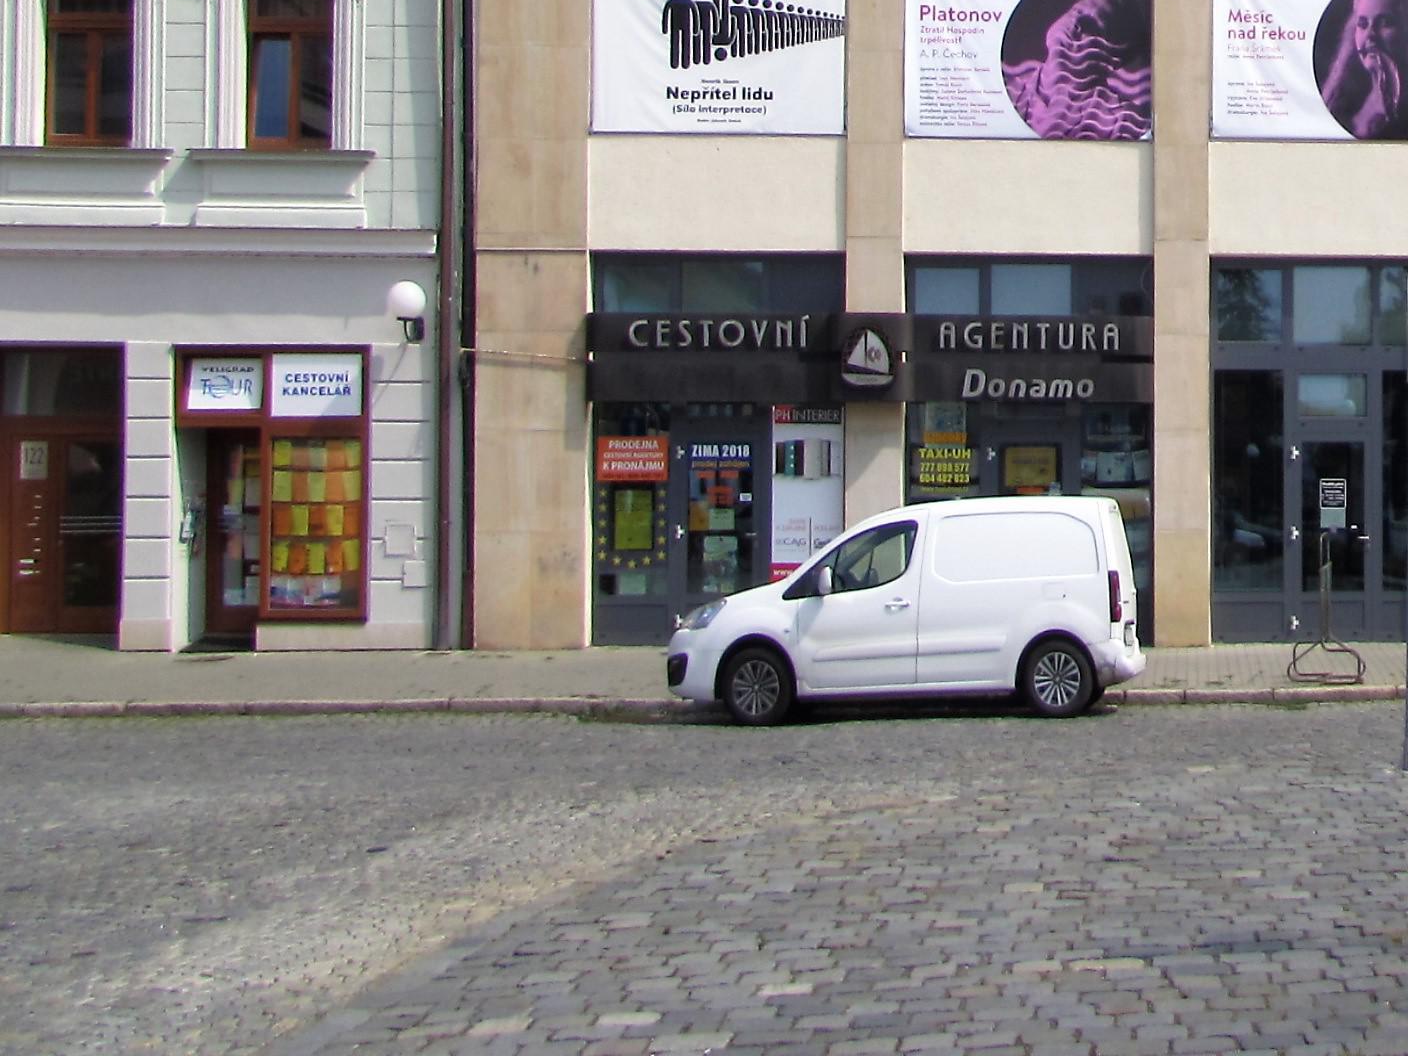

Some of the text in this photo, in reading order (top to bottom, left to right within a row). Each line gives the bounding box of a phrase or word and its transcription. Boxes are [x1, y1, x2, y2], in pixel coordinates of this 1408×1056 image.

[920, 4, 1002, 22] Platonov
[1228, 9, 1273, 24] Měsíc
[1228, 25, 1306, 41] nad řekou
[666, 86, 773, 103] Nepřítel lidu
[628, 314, 1120, 351] CESTOVNÍ AGENTURA
[285, 370, 349, 383] CESTOVNÍ
[962, 368, 1095, 398] Donamo
[282, 384, 351, 396] KANCELÁŘ
[608, 440, 659, 449] PRODEJNA
[692, 444, 750, 457] ZIMA 2018
[919, 448, 971, 459] TAXI-UH
[603, 460, 665, 470] K PRONÁJMU
